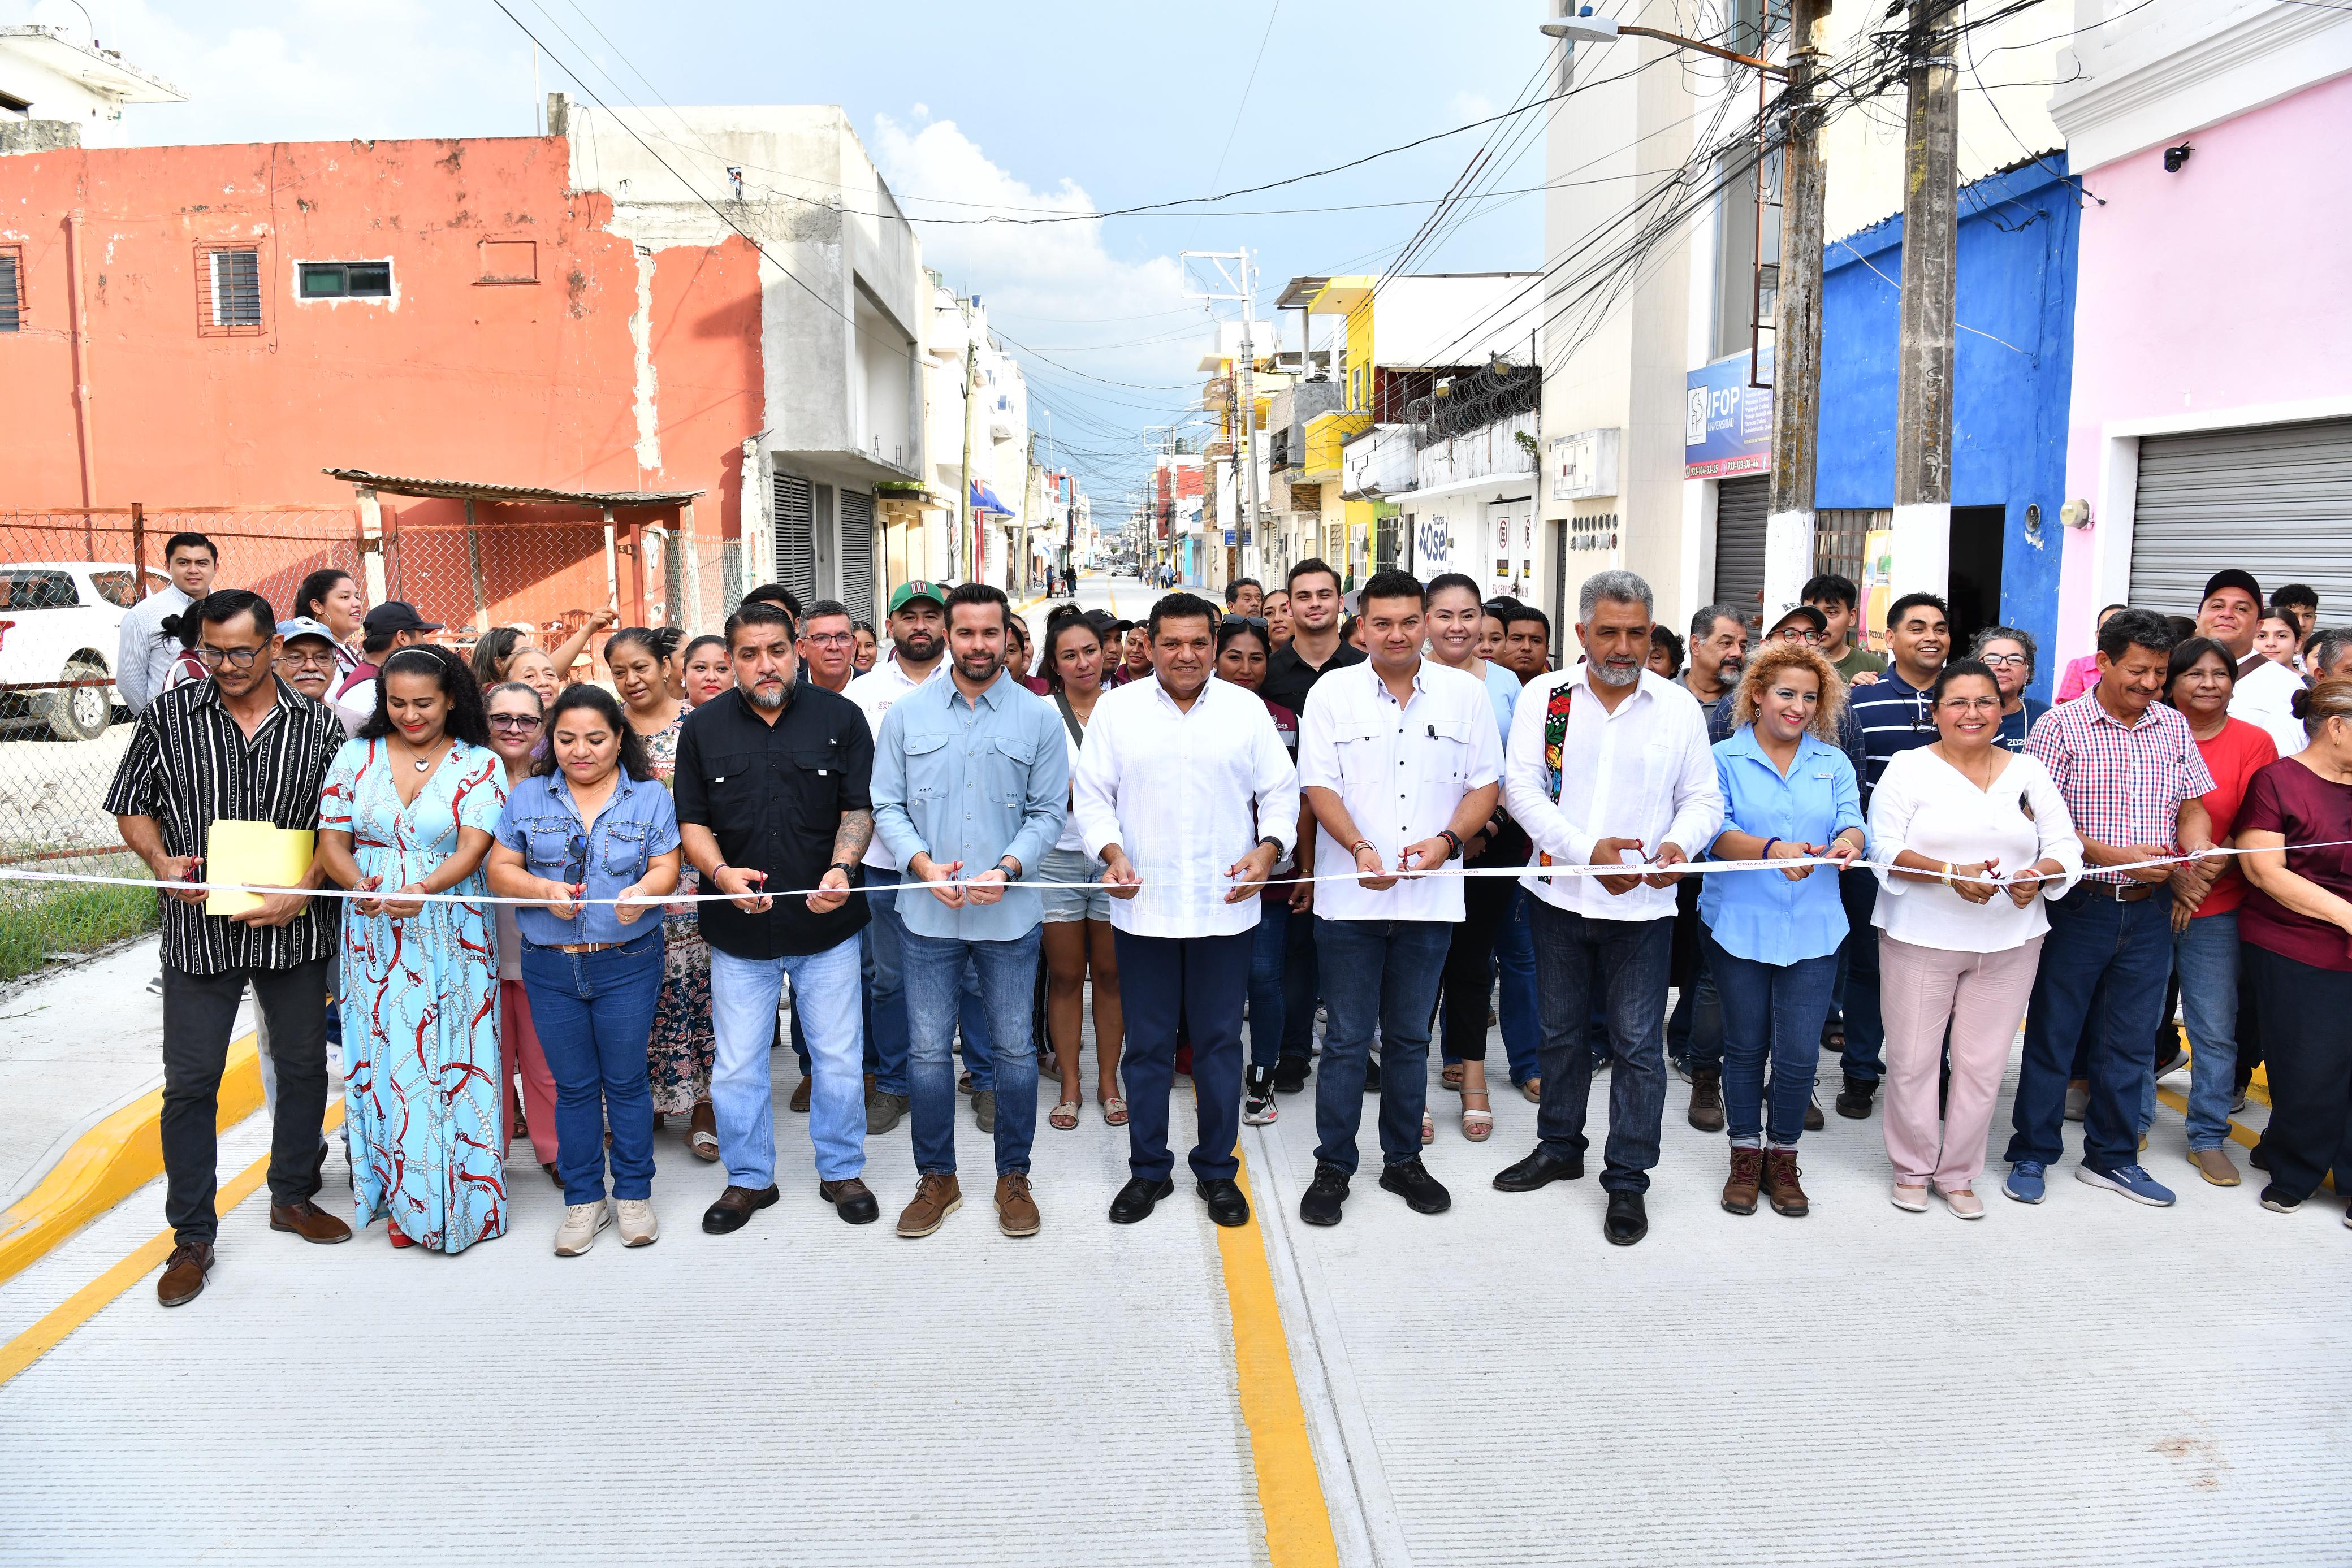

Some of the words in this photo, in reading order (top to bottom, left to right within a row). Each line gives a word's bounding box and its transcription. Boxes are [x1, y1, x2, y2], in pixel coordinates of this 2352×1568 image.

[1707, 418, 1734, 431] UNIVERSIDAD
[1690, 464, 1719, 475] 933-104-33-25
[1727, 457, 1759, 471] 933-123-08-66
[1432, 513, 1445, 525] Pinturas
[1426, 522, 1447, 561] Osel
